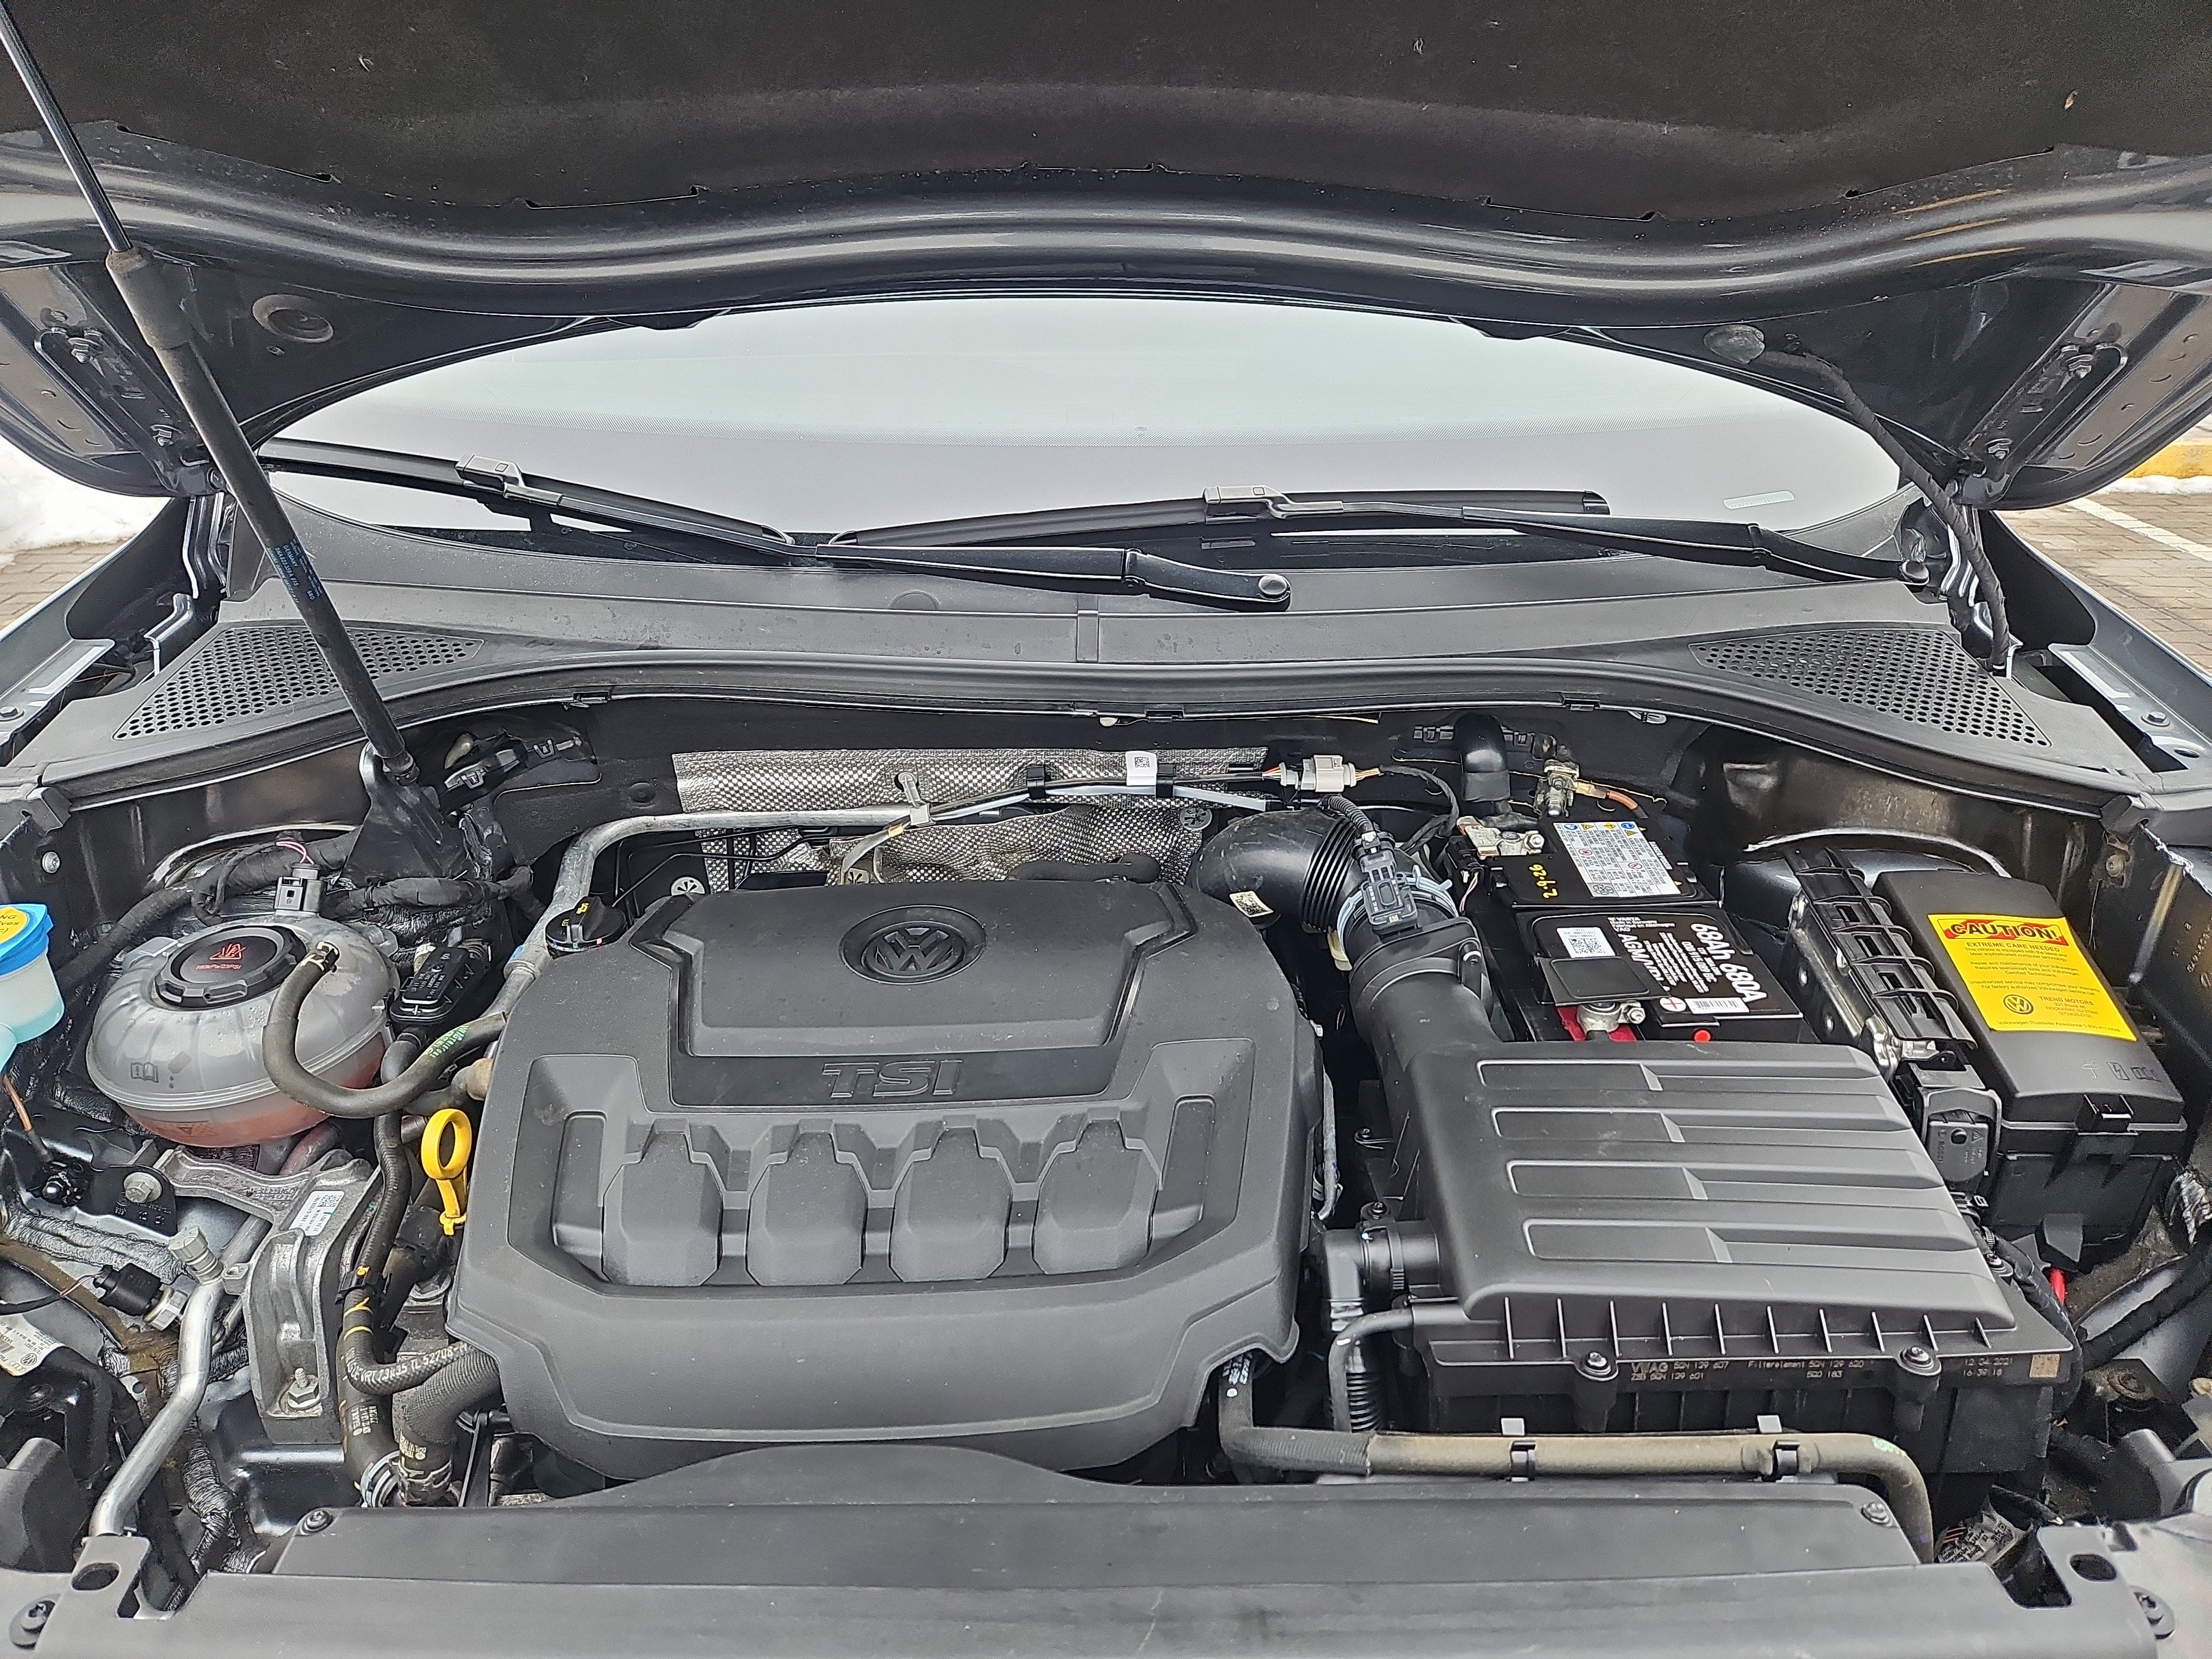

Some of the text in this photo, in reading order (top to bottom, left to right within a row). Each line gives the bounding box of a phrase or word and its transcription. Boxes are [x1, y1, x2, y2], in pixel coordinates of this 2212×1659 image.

[1950, 923, 2060, 941] CAUTION!
[1691, 923, 1735, 960] 68Ah
[1720, 963, 1767, 1002] 680A
[2064, 998, 2094, 1006] MOTORS
[822, 1059, 963, 1099] TSI
